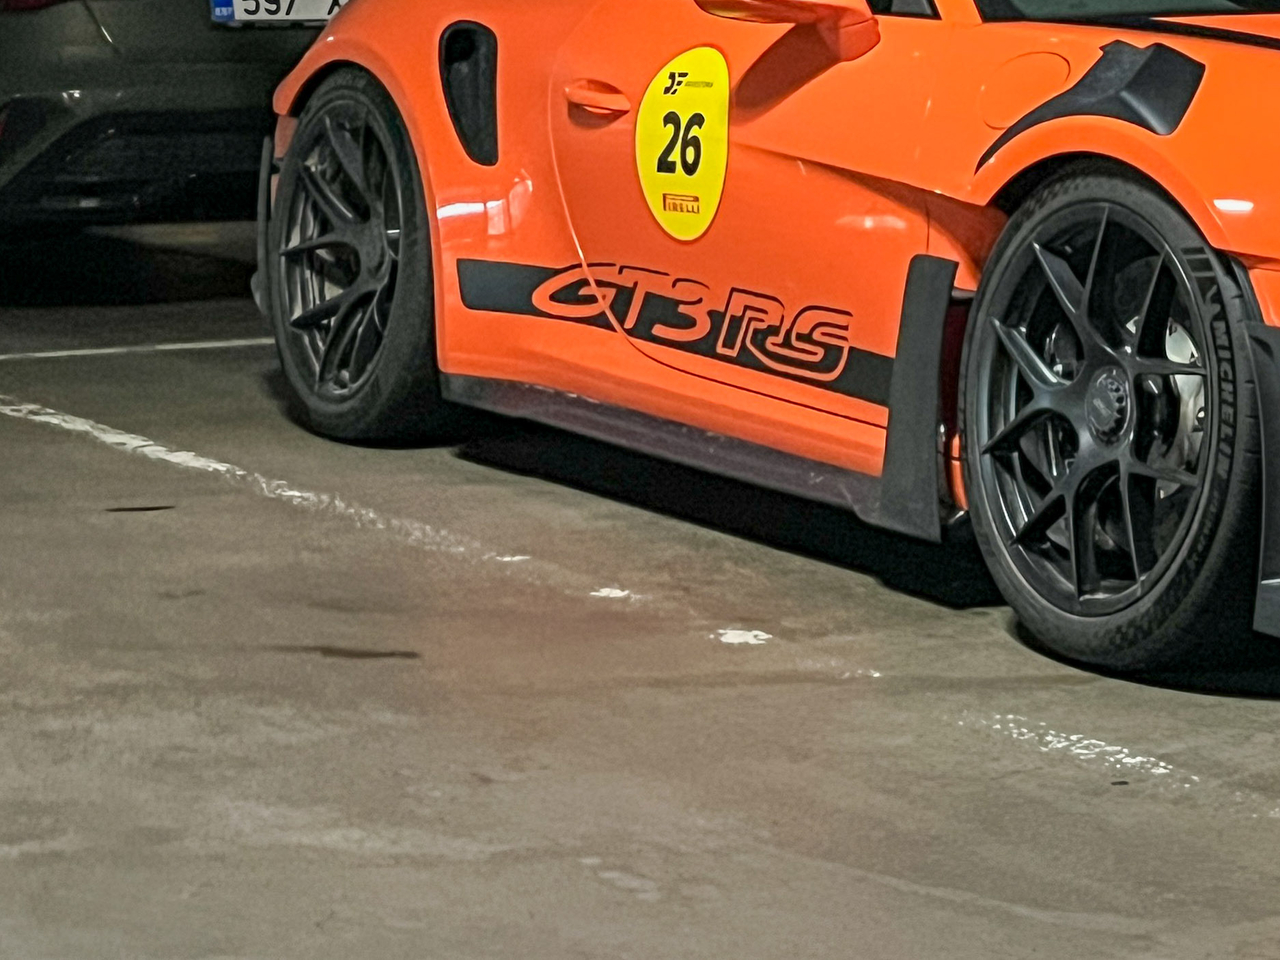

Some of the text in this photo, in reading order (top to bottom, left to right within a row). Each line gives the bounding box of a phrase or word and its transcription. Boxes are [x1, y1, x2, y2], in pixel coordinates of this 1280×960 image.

[656, 110, 706, 177] 26
[662, 192, 700, 214] PIRELLI
[1211, 320, 1234, 480] MICHELIN
